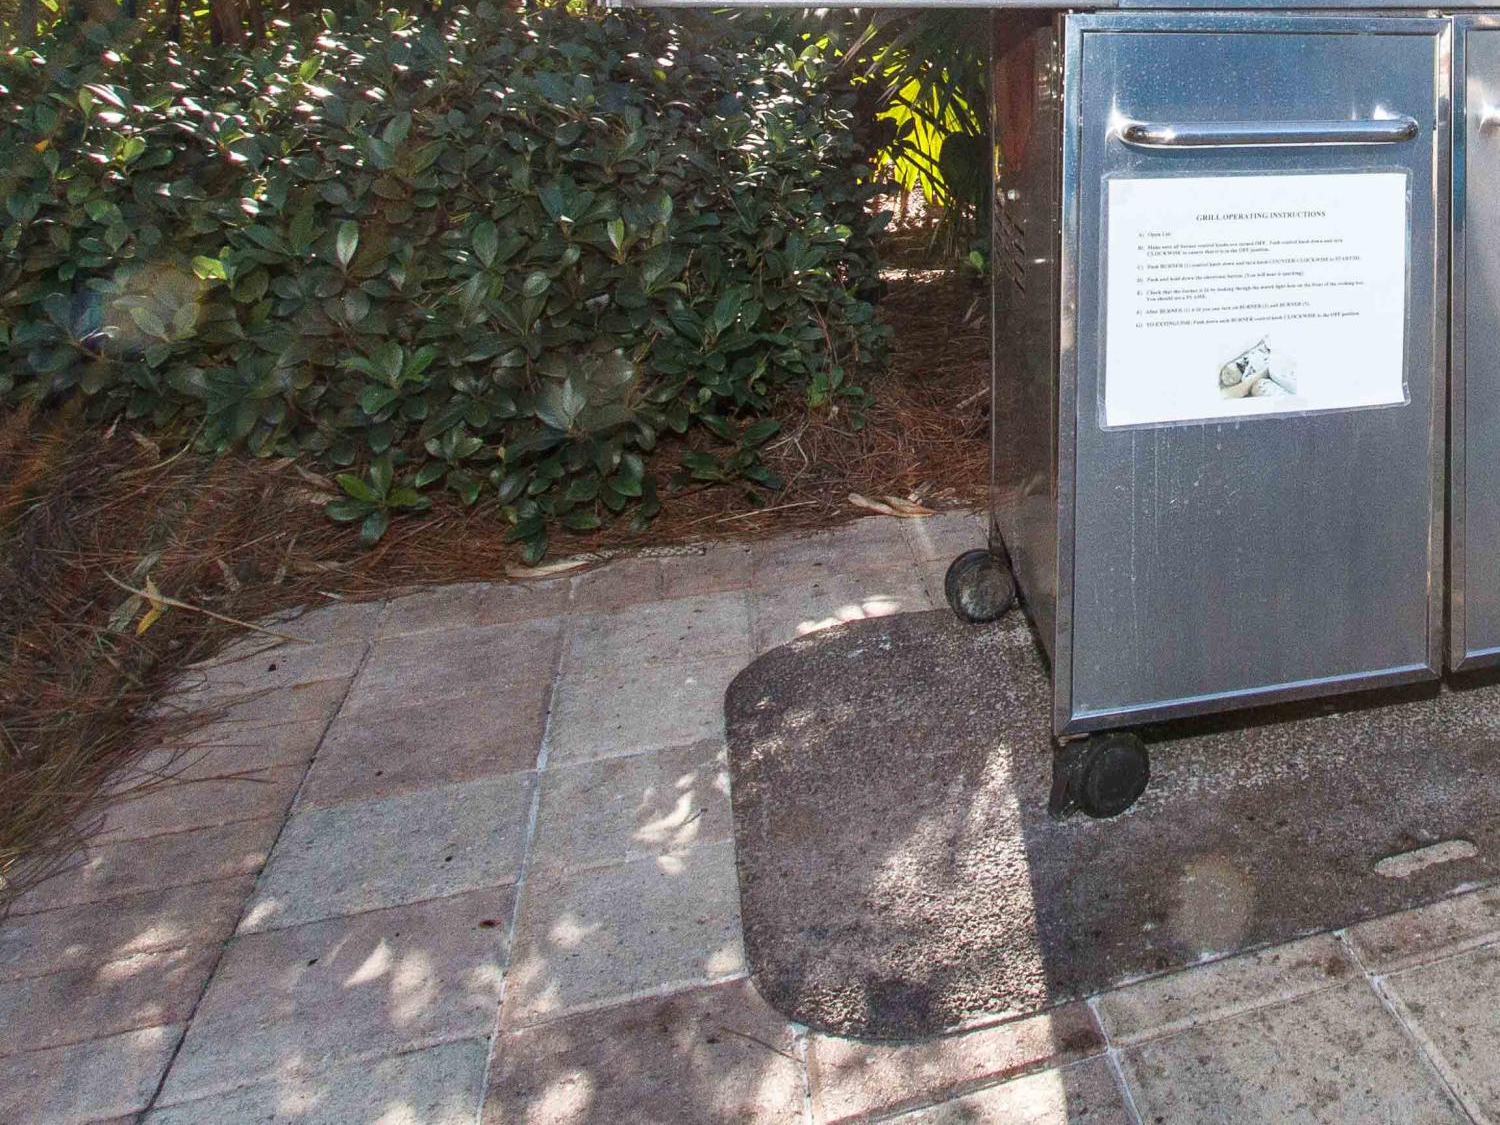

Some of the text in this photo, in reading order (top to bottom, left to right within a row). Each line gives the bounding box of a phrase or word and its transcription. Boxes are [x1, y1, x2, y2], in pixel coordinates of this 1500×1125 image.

[1196, 210, 1327, 222] GRILL OPERATING INSTRUCTIONS
